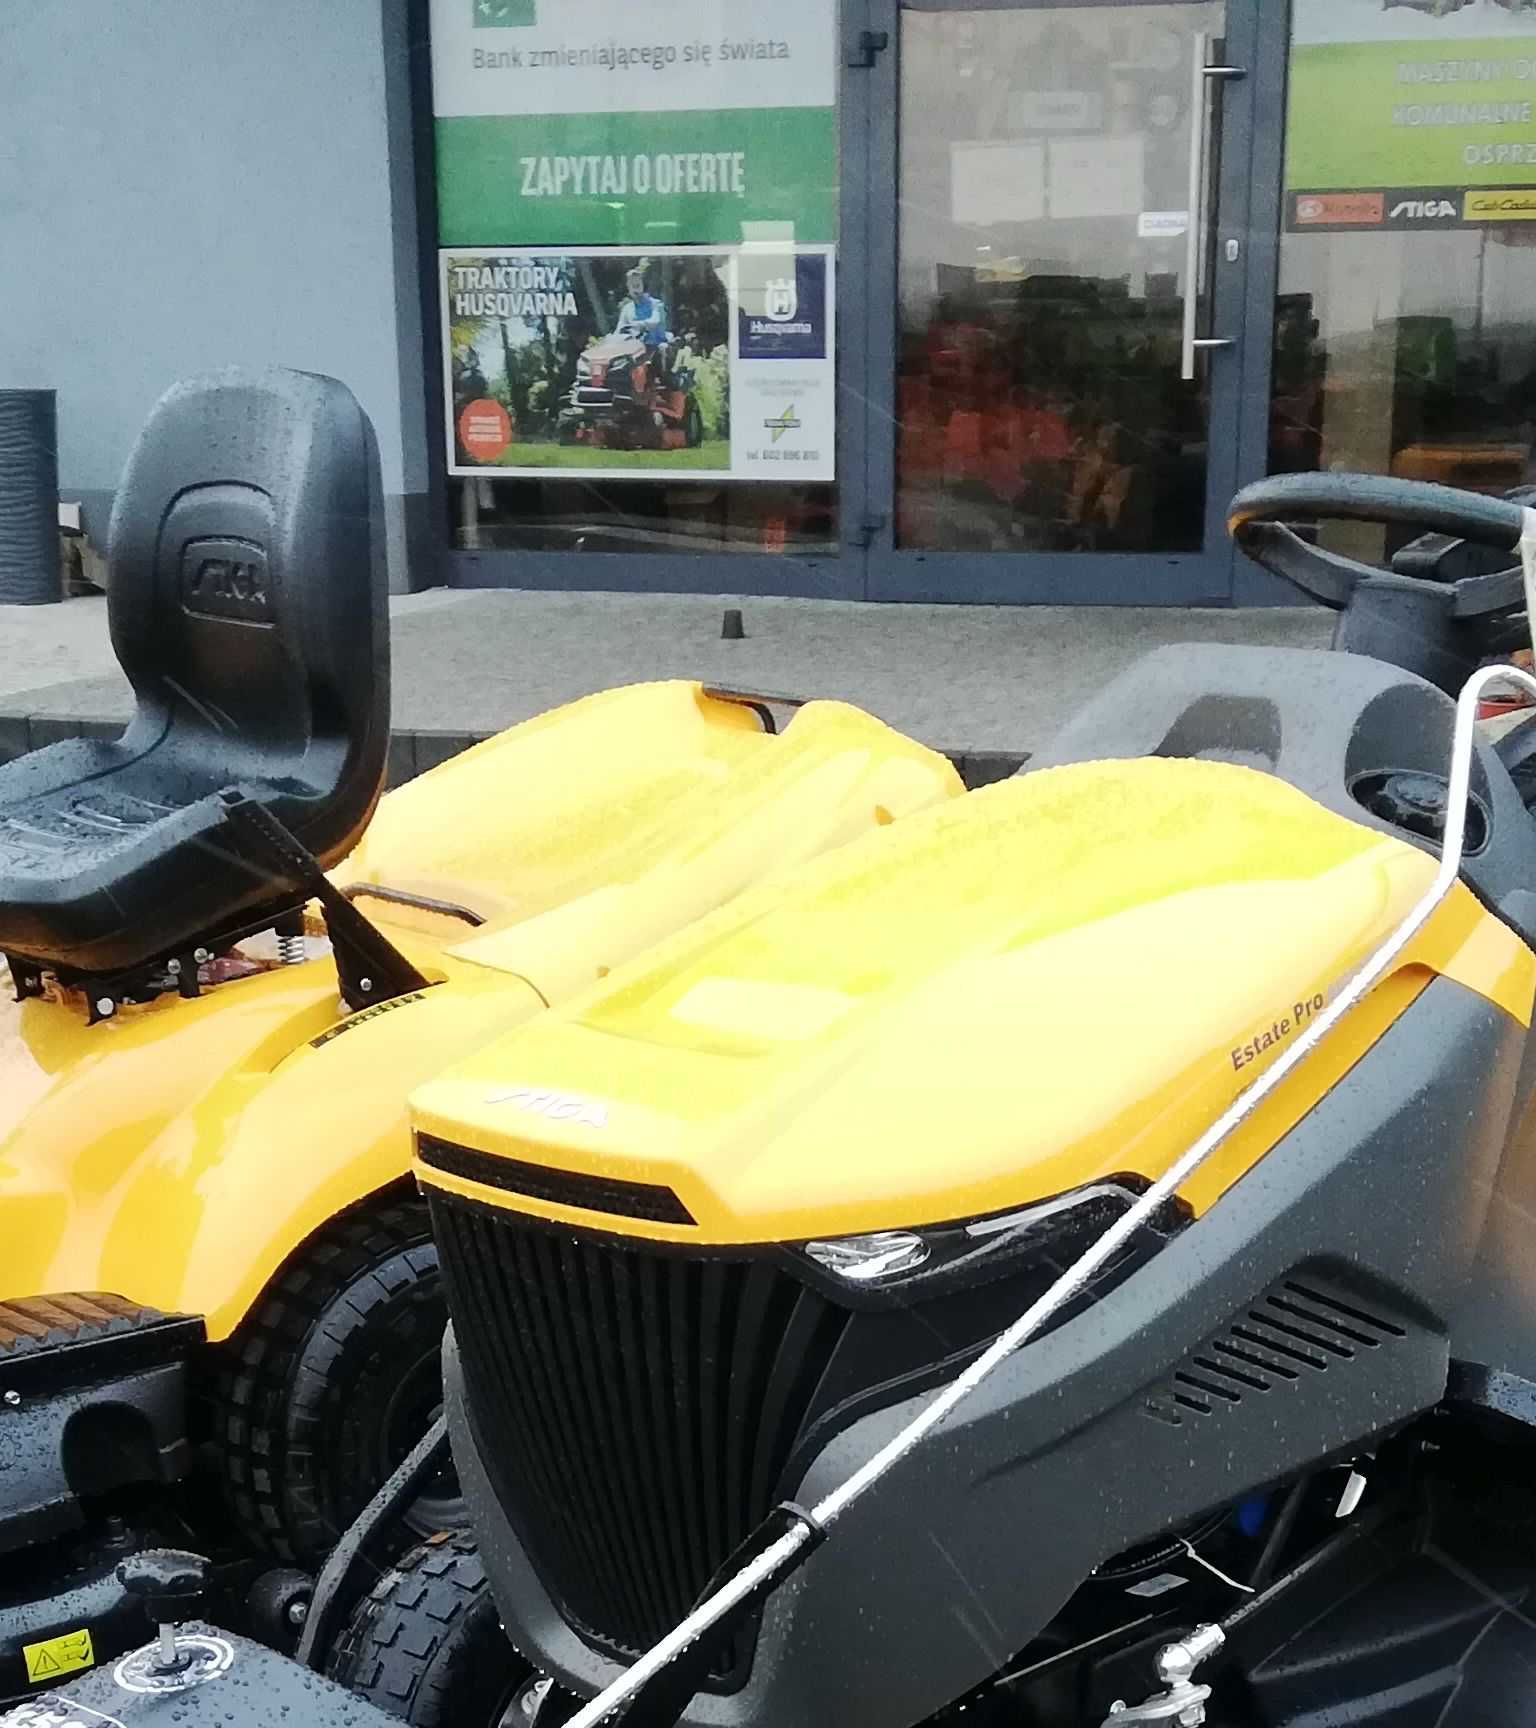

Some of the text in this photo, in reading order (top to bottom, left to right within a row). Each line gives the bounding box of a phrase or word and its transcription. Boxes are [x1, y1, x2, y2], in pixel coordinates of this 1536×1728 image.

[473, 38, 790, 70] Bank zmieniającego się świata
[520, 150, 745, 198] ZAPYTAJ O OFERTĘ
[1390, 200, 1457, 218] STIGA
[455, 292, 578, 317] HUSQVARNA
[1231, 993, 1324, 1071] Estate Pro
